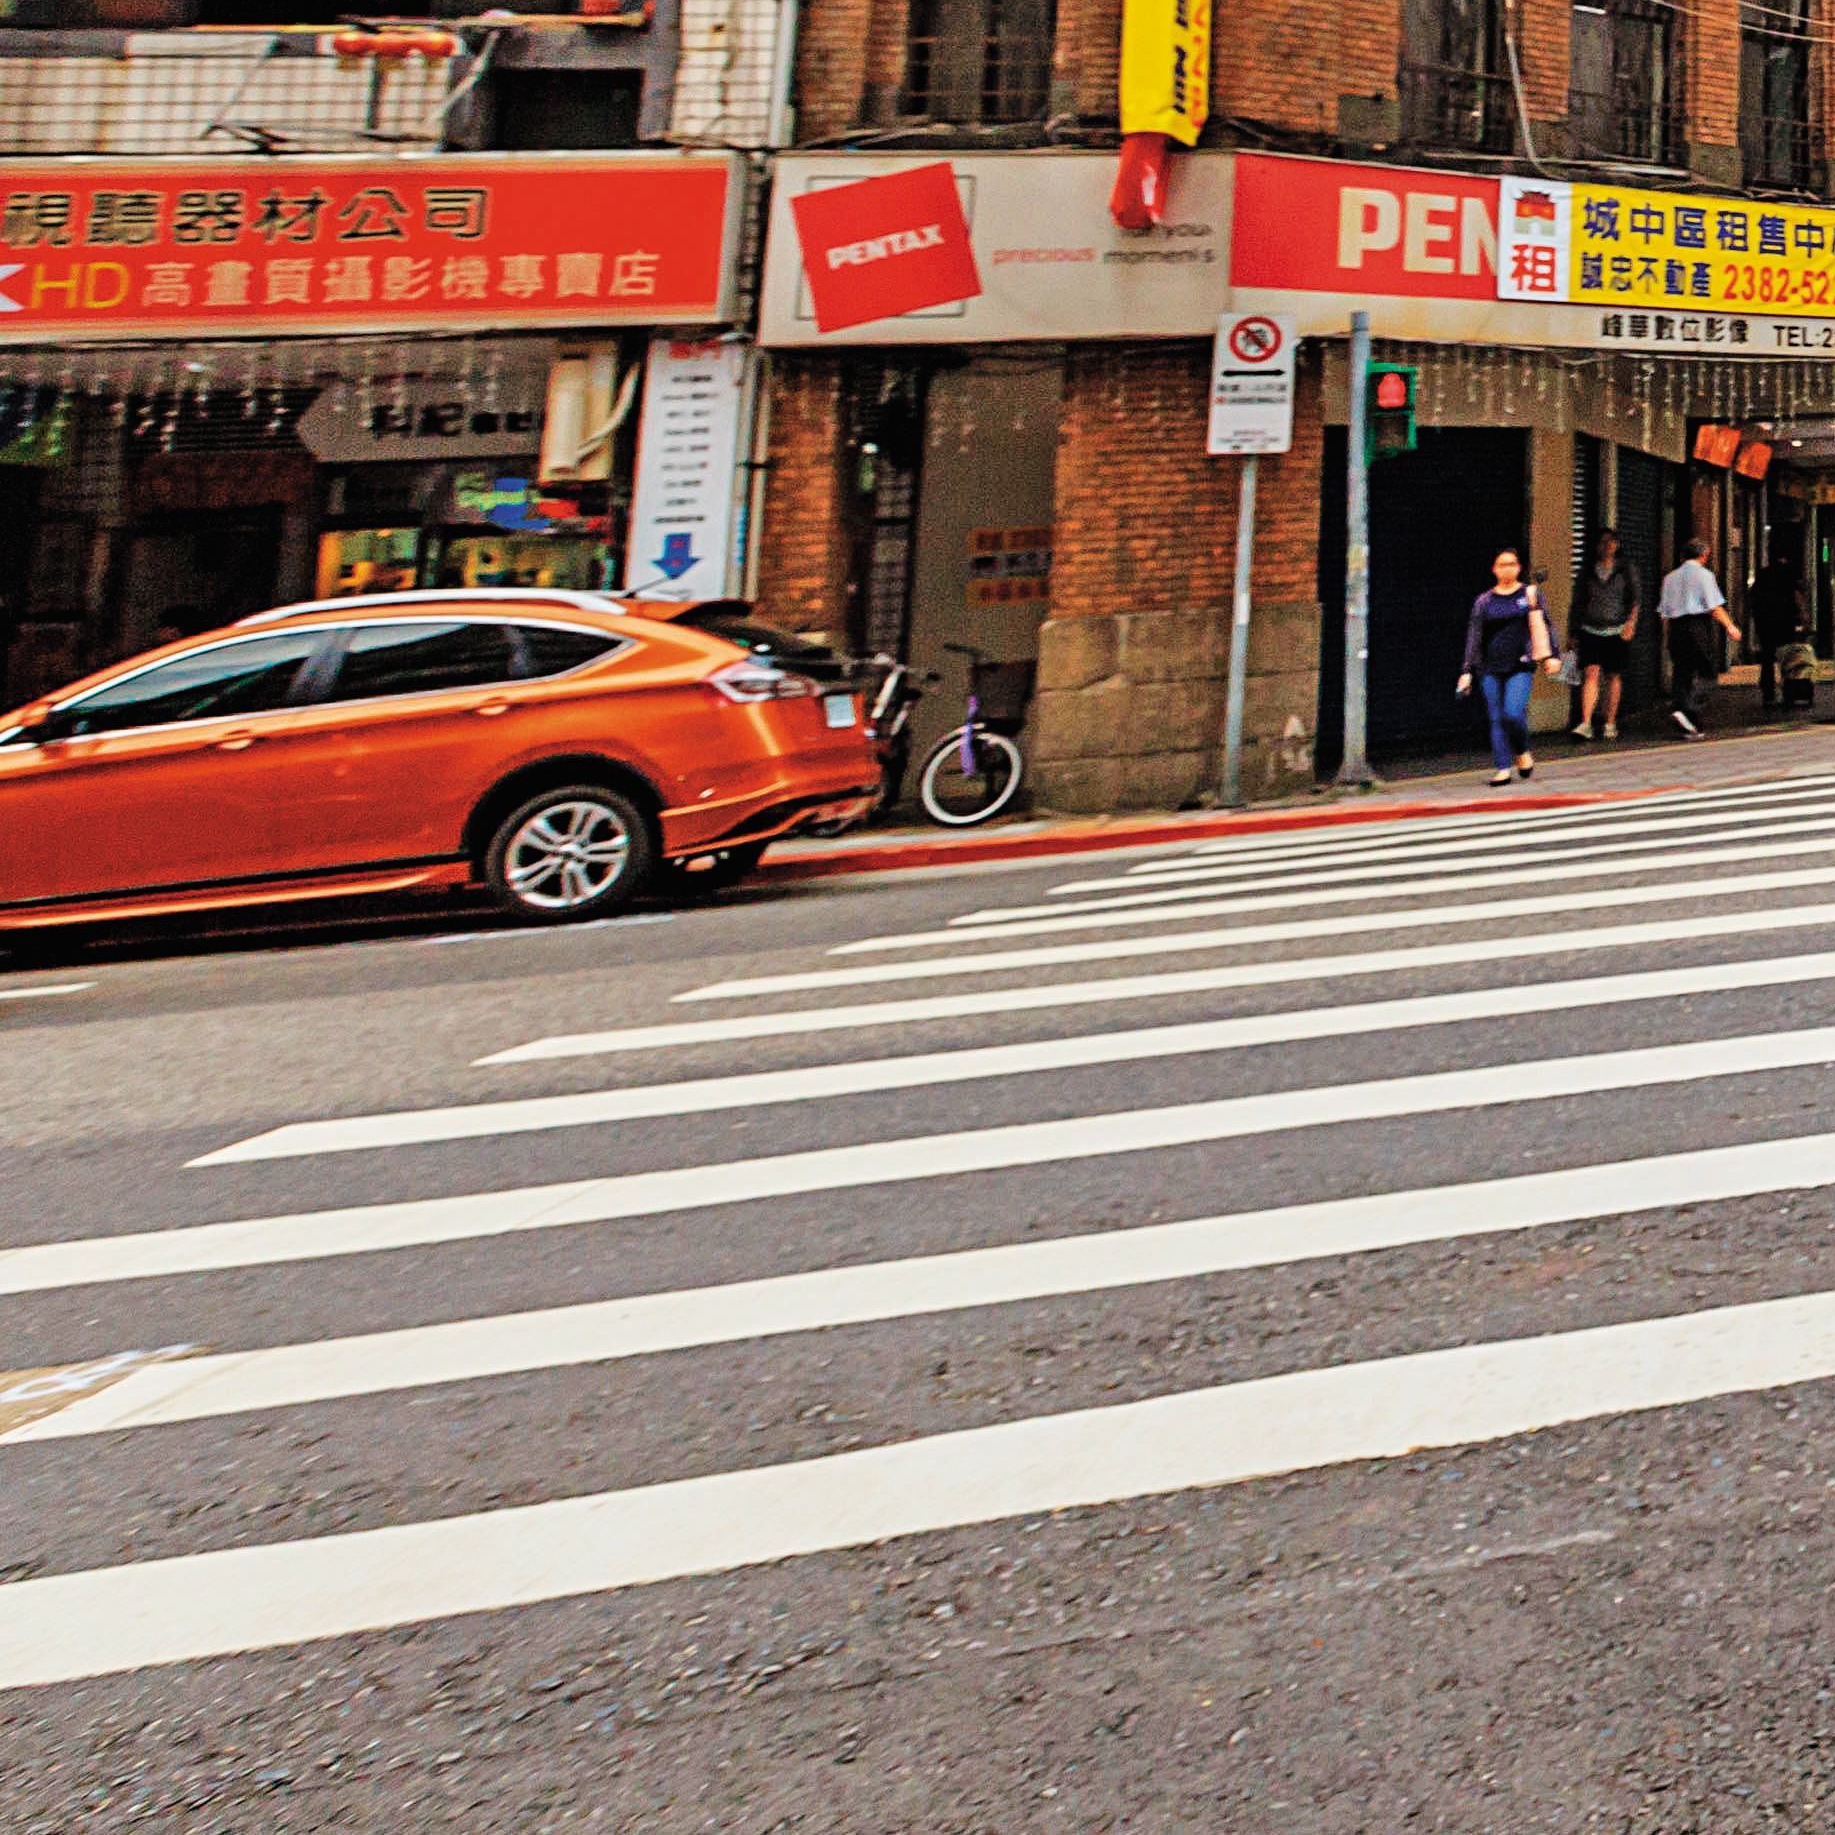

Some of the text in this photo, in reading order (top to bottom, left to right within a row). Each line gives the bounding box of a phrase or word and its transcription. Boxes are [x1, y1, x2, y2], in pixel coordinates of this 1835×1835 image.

[826, 224, 944, 269] PENTAX
[1511, 244, 1557, 293] 租
[1580, 251, 1712, 298] 誠忠不動產
